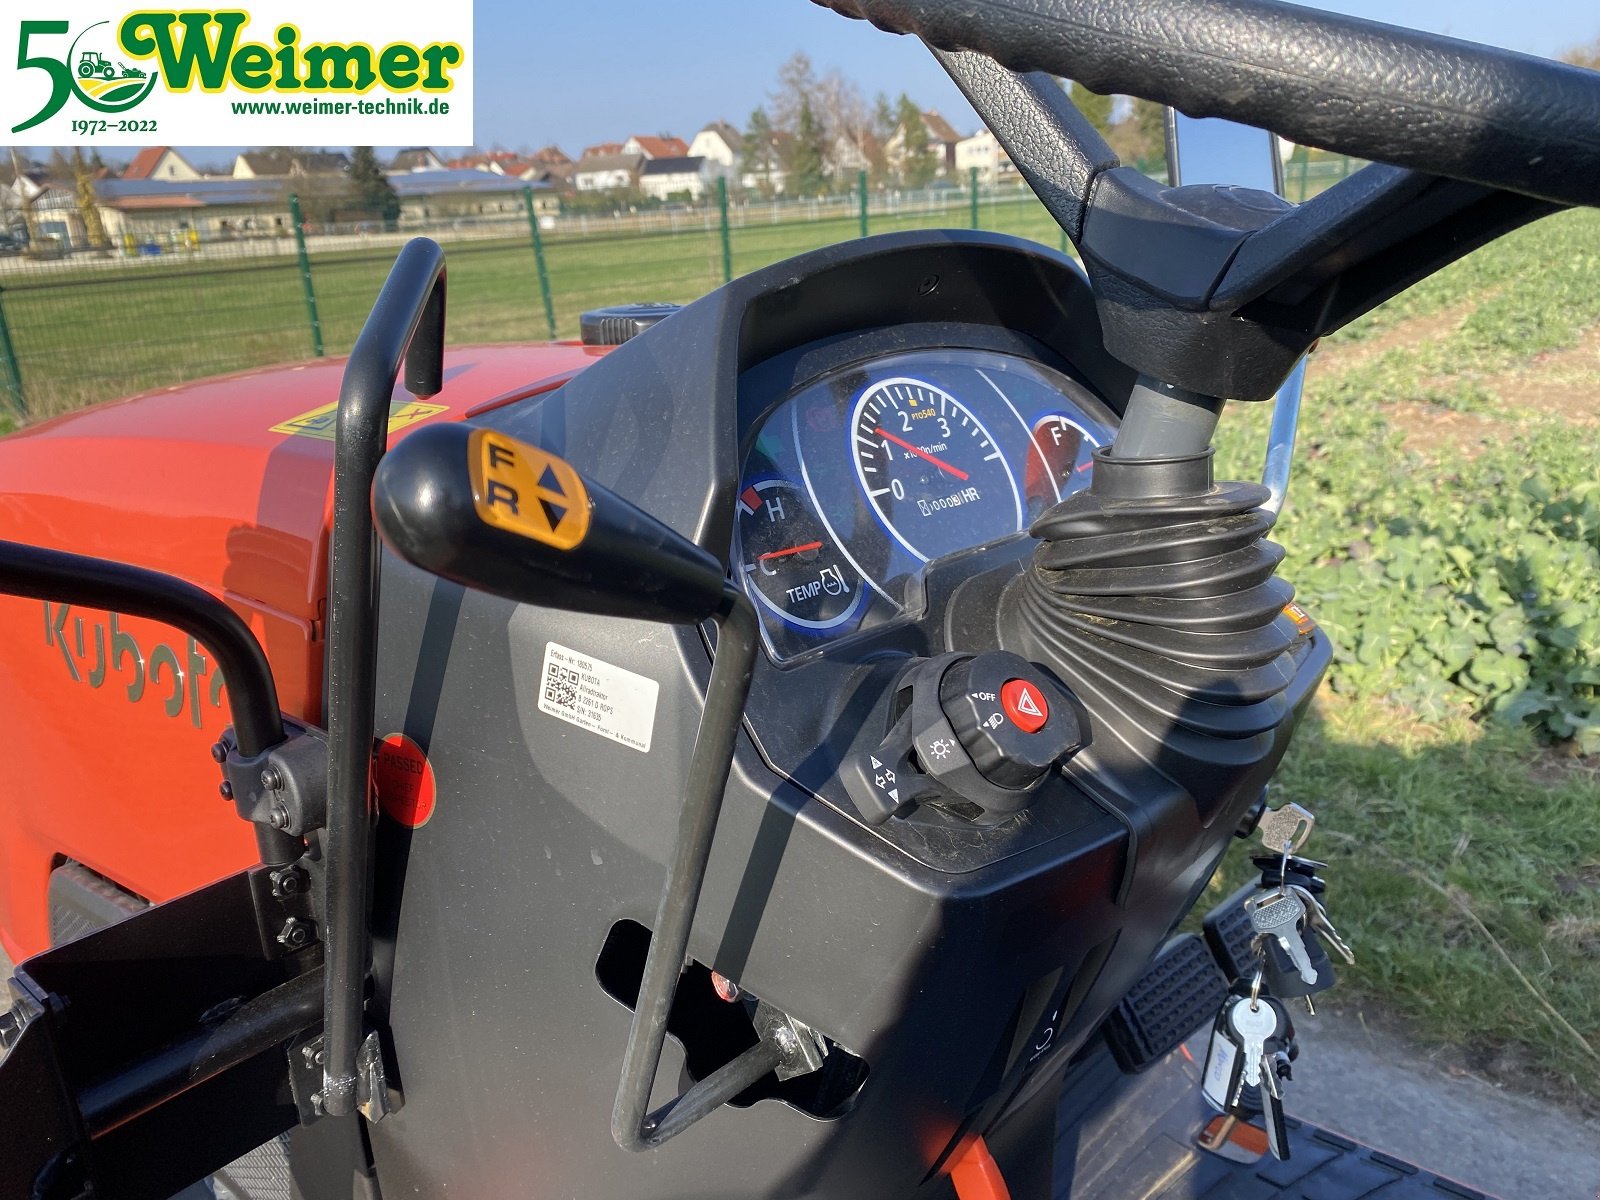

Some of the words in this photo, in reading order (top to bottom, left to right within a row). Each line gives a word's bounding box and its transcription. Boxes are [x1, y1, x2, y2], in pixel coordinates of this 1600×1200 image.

[897, 410, 913, 432] 2
[911, 408, 936, 420] PTO540
[936, 417, 951, 438] 3
[1050, 426, 1062, 446] F
[489, 444, 515, 469] F
[880, 440, 894, 461] 1
[486, 479, 519, 516] R
[891, 479, 906, 502] 0
[766, 496, 786, 522] H
[785, 580, 822, 604] TEMP
[581, 672, 600, 685] KUBOTA
[580, 684, 608, 701] Allradtraktor
[978, 692, 996, 702] OFF
[384, 752, 424, 774] PASSED
